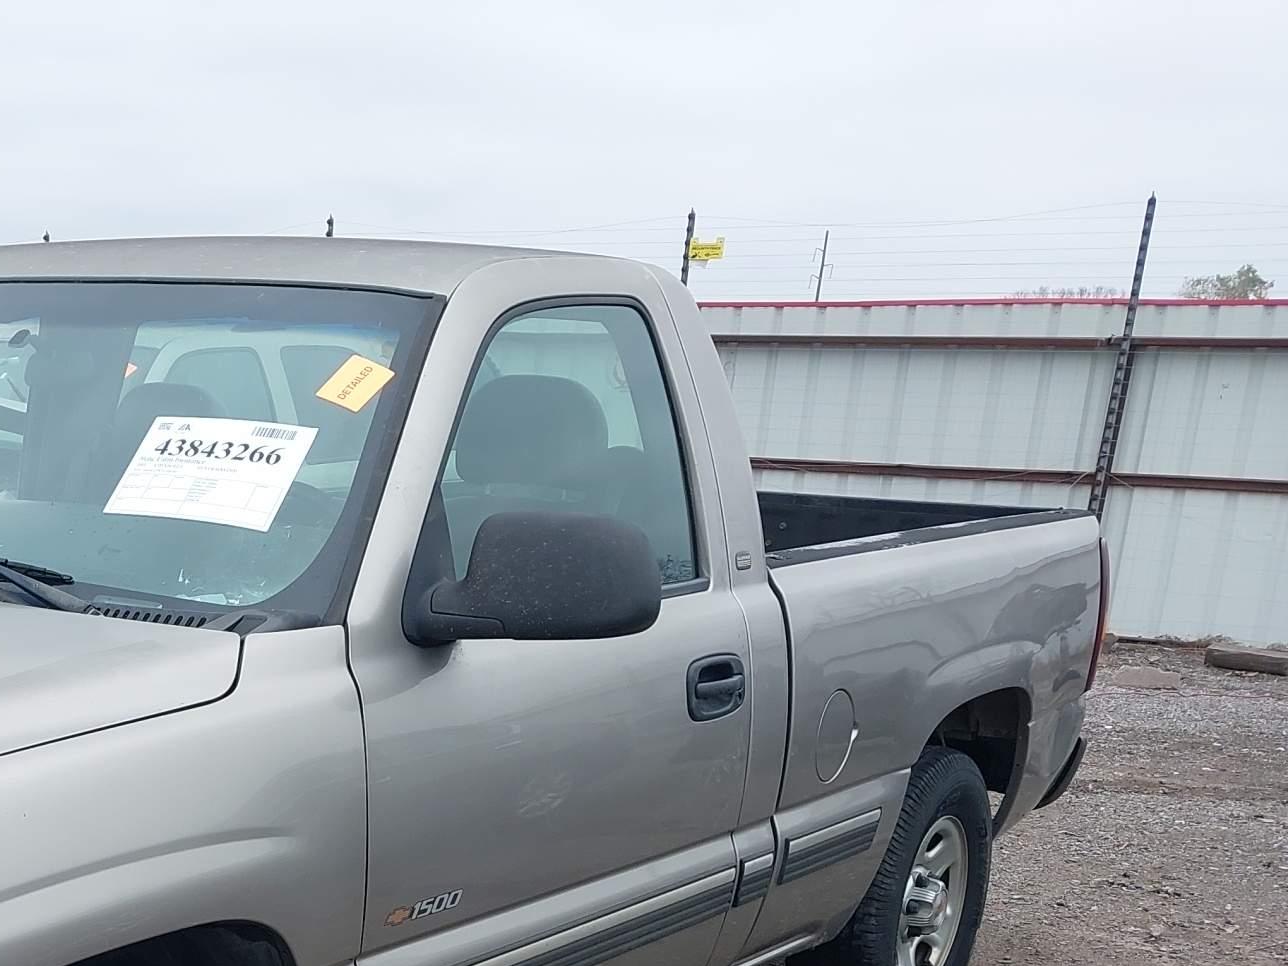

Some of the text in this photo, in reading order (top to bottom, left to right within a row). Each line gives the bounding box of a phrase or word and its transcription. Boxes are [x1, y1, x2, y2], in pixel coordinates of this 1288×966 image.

[337, 366, 373, 400] DETAILED
[154, 438, 285, 465] 43843266
[411, 889, 463, 920] 1500
